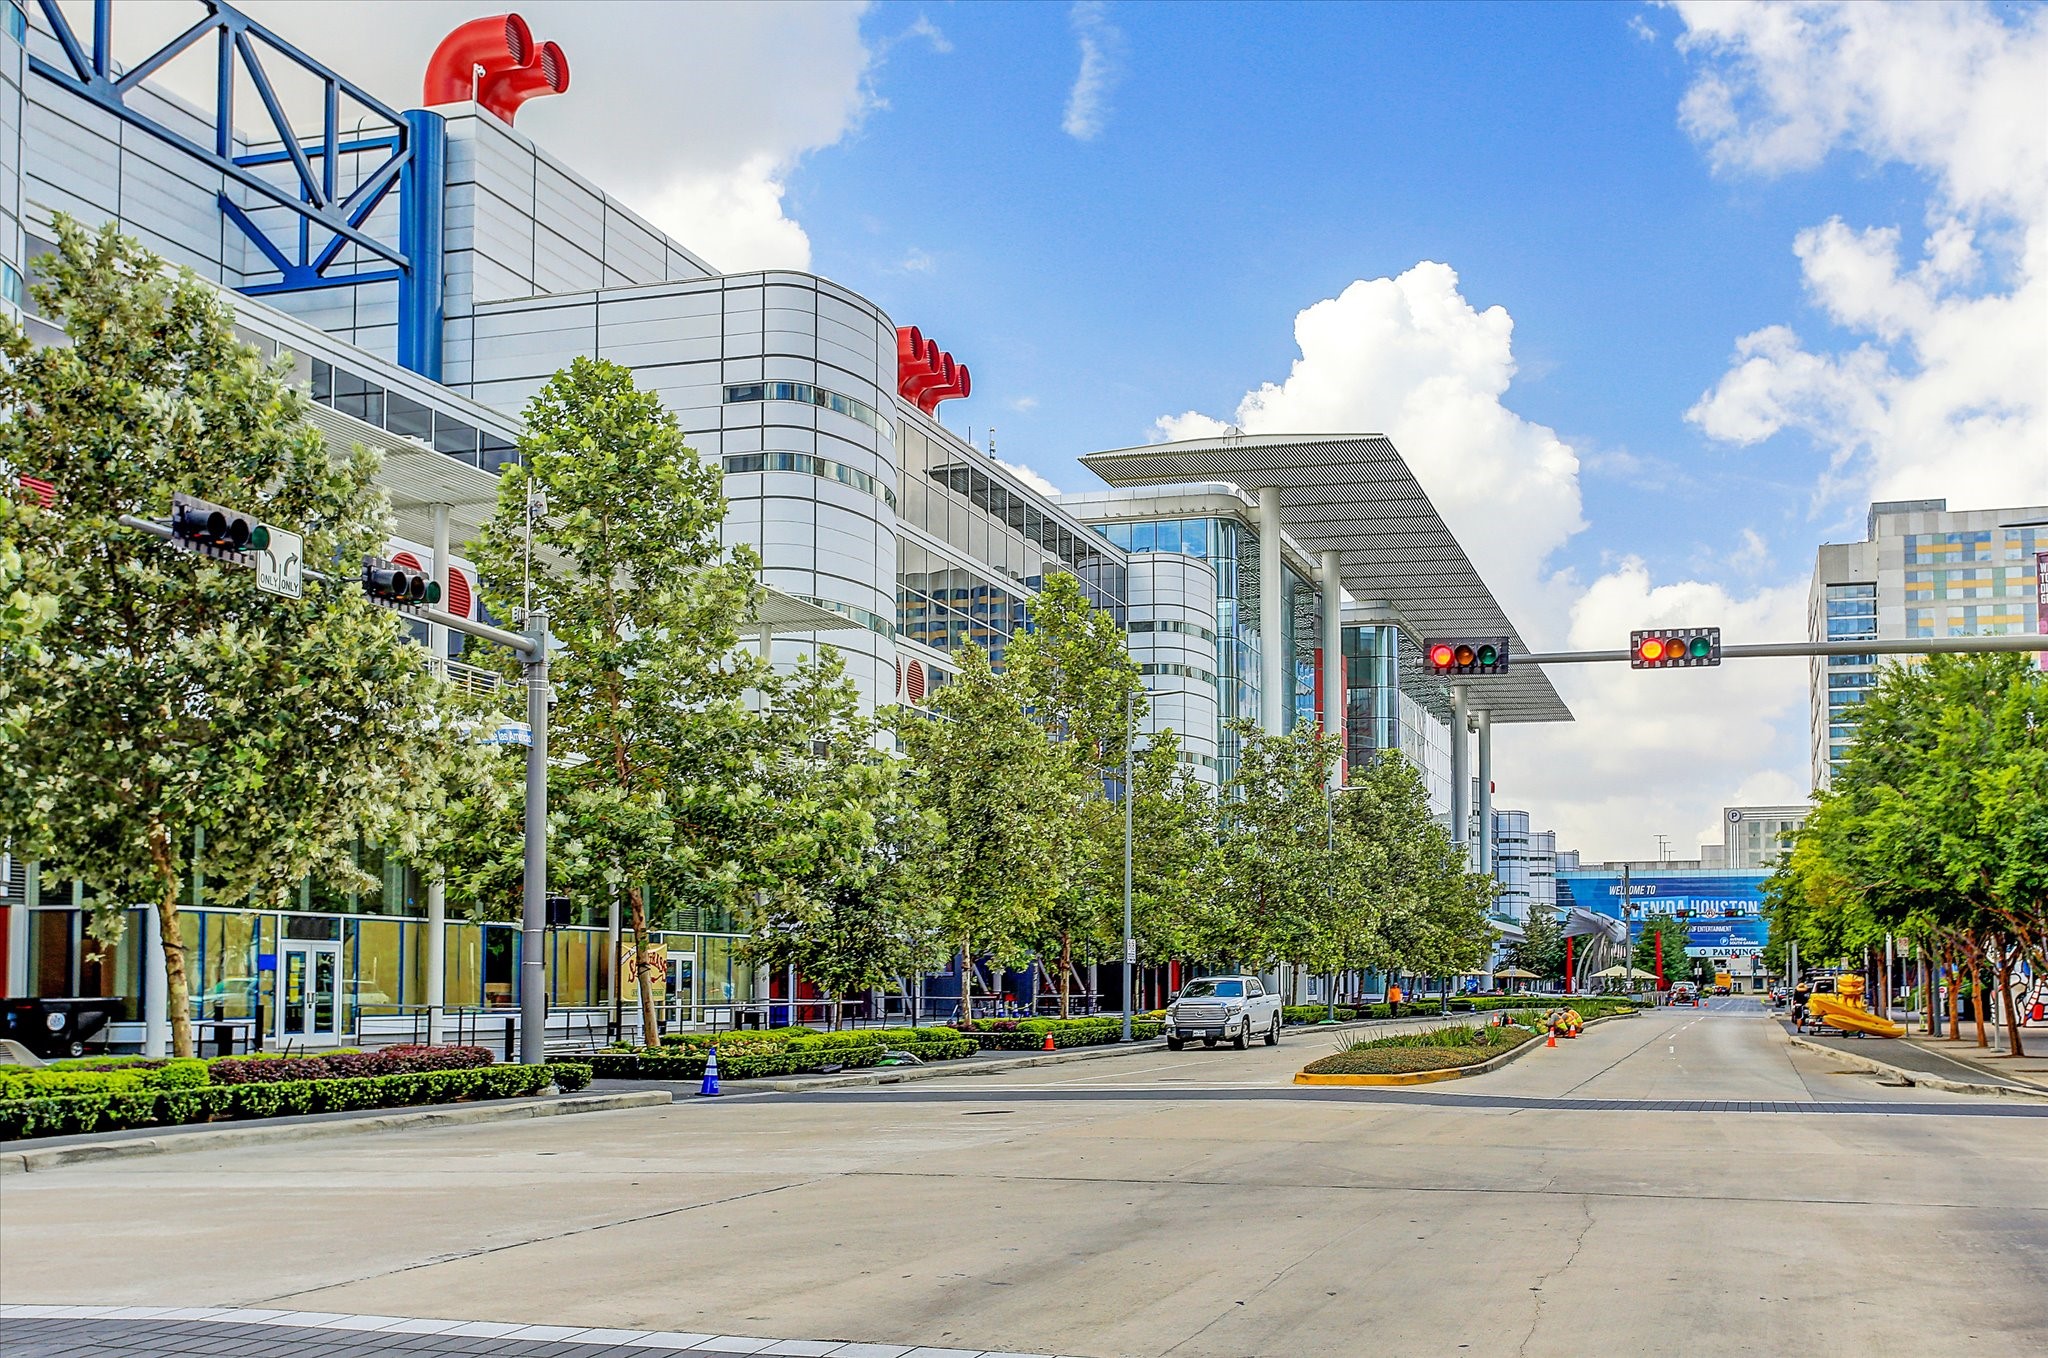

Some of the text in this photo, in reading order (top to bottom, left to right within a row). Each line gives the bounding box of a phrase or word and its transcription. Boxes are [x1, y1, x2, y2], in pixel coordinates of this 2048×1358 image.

[260, 573, 299, 592] ONLY ONLY
[1609, 885, 1656, 896] WELOME TO
[1691, 899, 1758, 918] HOUSTON
